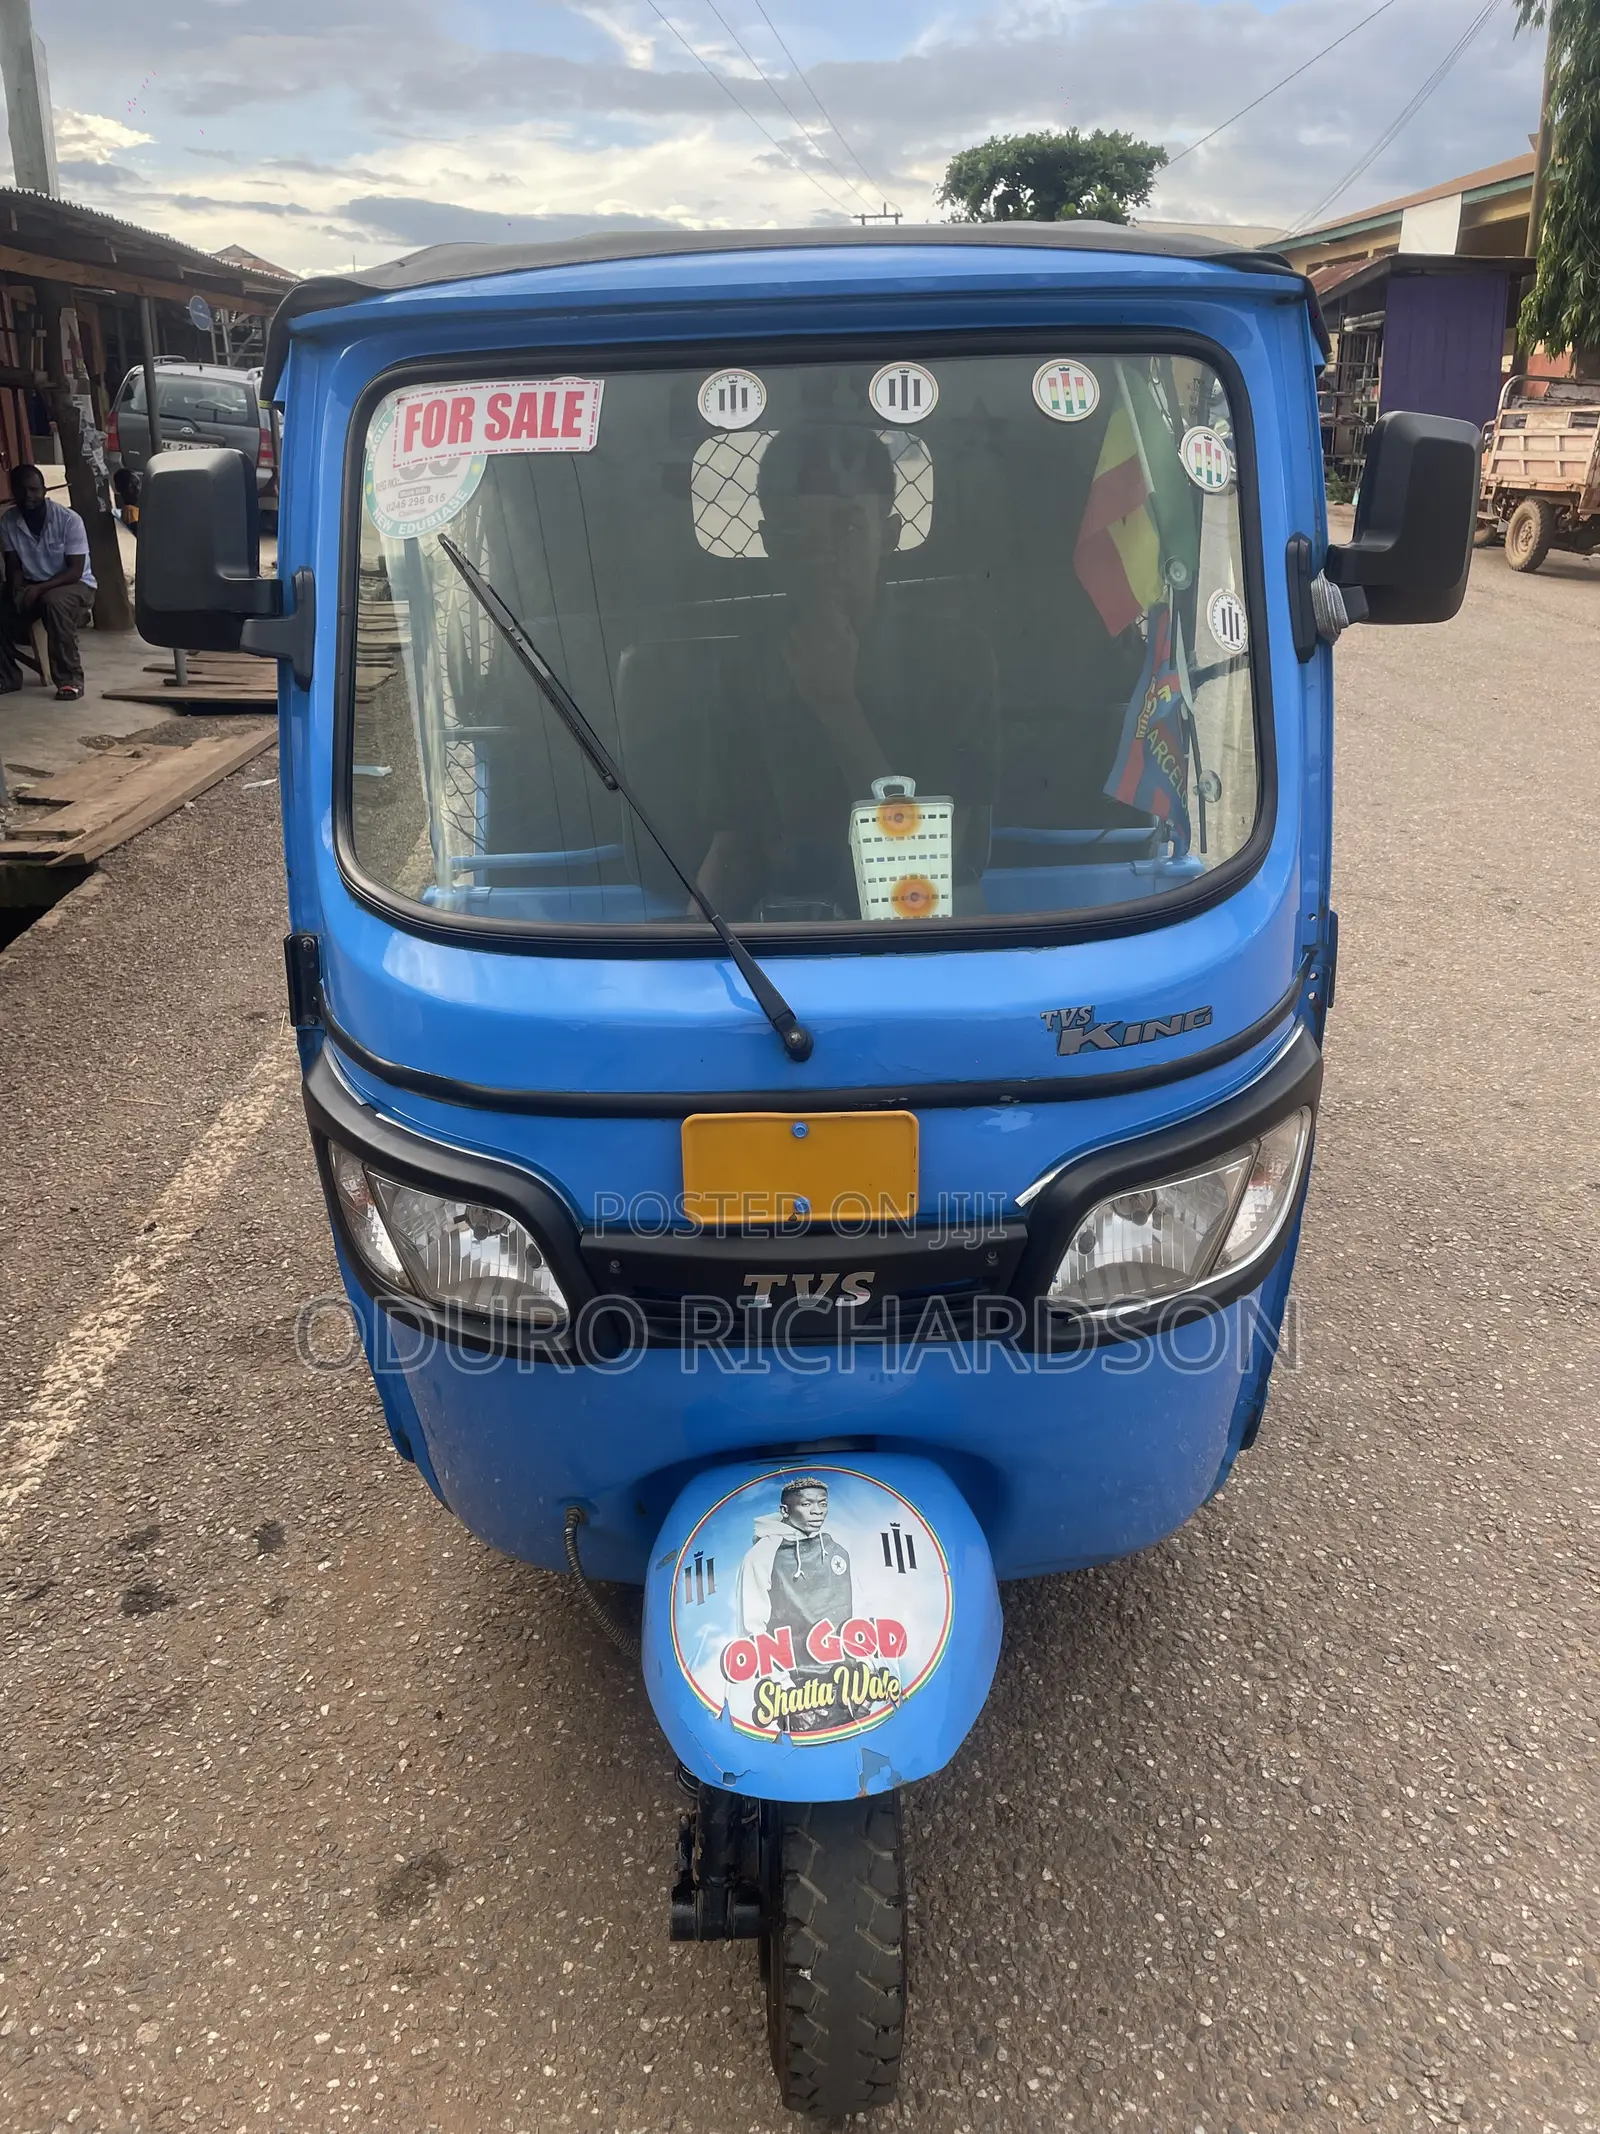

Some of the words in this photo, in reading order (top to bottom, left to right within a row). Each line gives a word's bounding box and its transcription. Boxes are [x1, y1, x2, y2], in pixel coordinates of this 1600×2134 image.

[403, 396, 476, 453] FOR
[484, 391, 585, 441] SALE
[372, 507, 394, 532] NEW
[398, 491, 467, 535] EDUBIASE
[1040, 1005, 1095, 1031] TVS
[1057, 1005, 1212, 1056] KING
[742, 1272, 876, 1309] TVS
[722, 1625, 796, 1684] ON
[806, 1618, 908, 1664] GOD
[755, 1678, 835, 1725] Shatta
[833, 1663, 900, 1704] Wale
